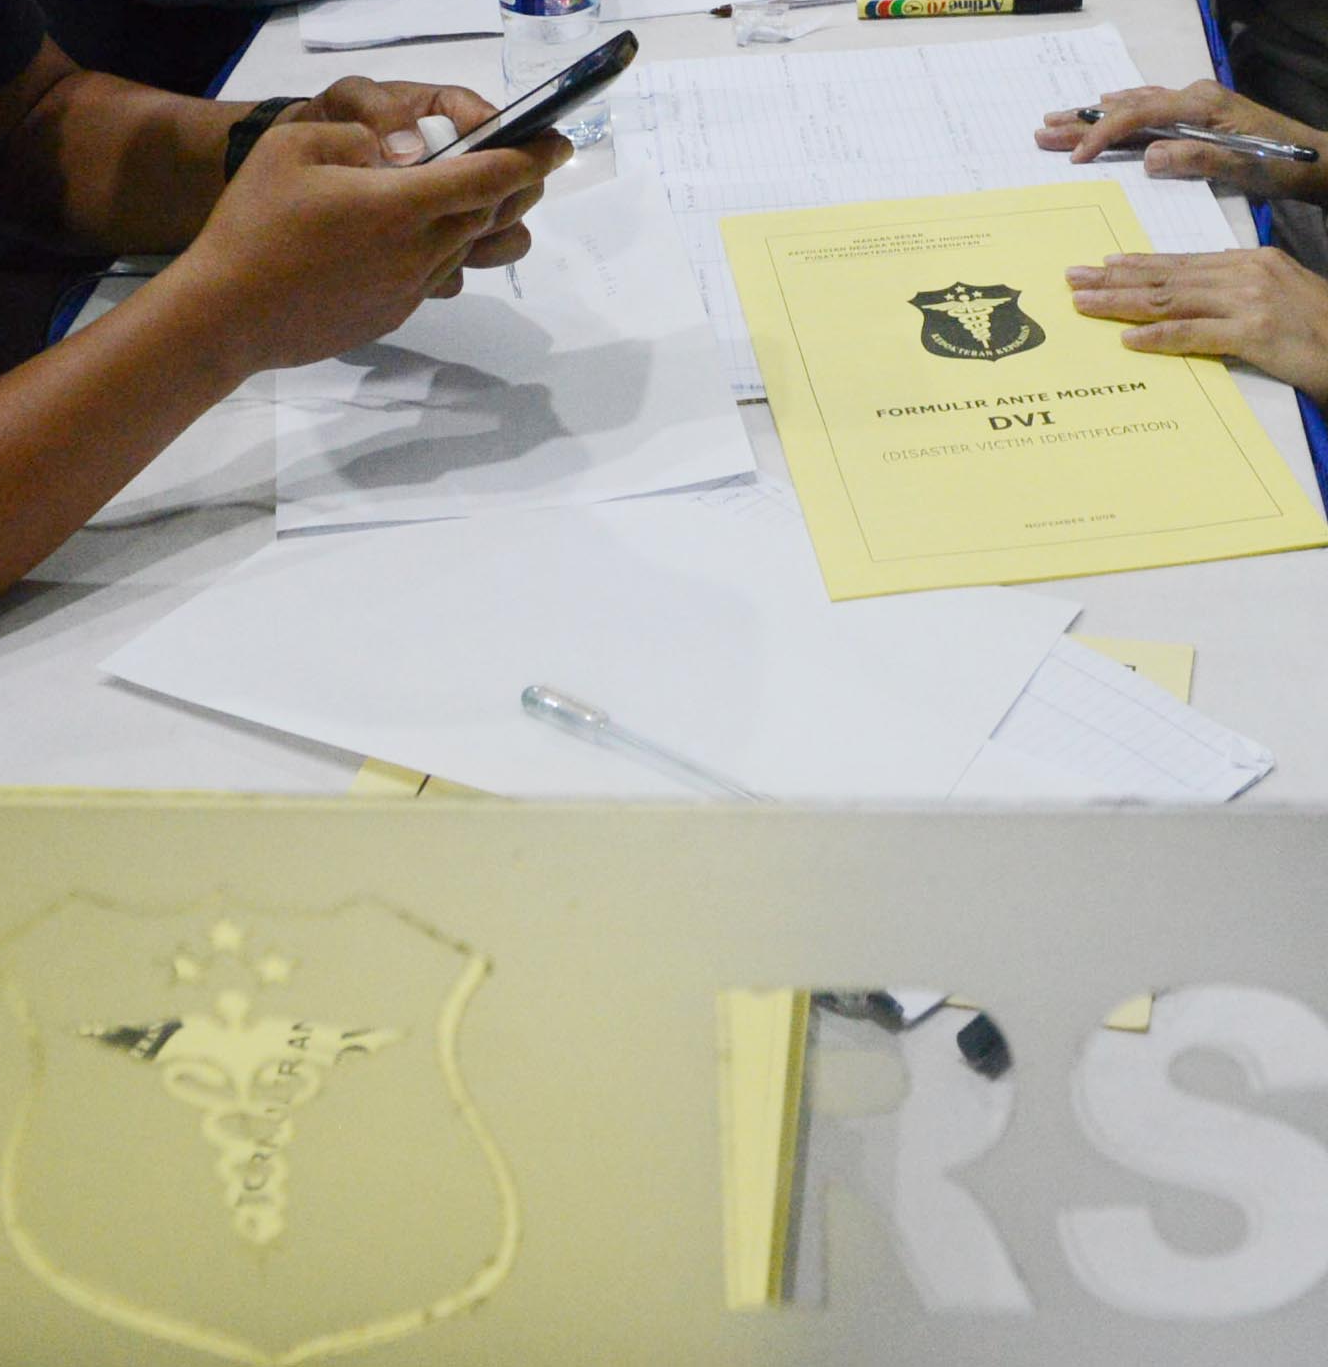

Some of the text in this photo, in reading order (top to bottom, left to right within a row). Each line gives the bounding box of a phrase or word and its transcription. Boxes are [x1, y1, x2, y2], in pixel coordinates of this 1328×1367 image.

[948, 0, 1004, 14] Artline
[876, 381, 1147, 418] FORMULIR ANTE MORTEM
[988, 410, 1056, 431] DVI
[881, 419, 1179, 464] (DISASTER VICTIM IDENTIFICATION)
